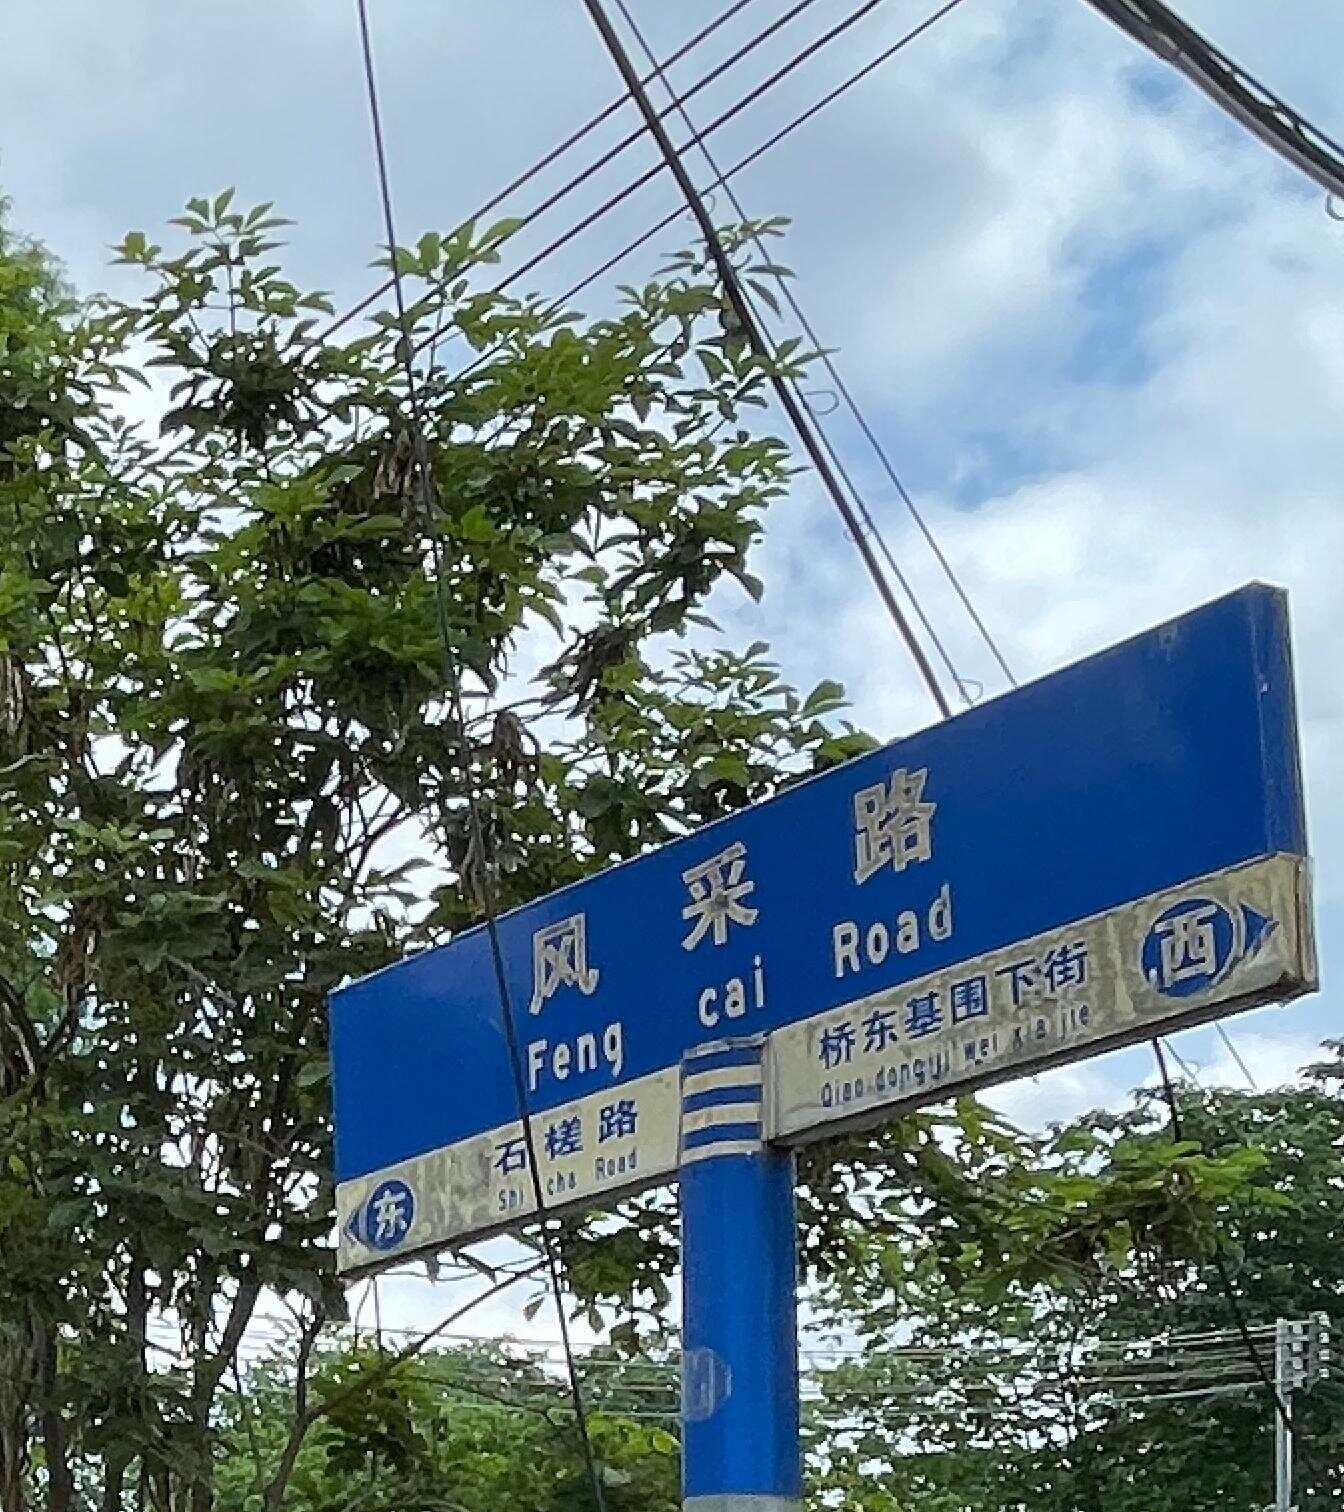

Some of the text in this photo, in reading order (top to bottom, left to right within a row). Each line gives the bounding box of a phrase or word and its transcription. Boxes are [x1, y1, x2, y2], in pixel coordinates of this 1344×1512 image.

[529, 767, 937, 1015] 风采路
[527, 882, 953, 1092] Feng cai Road
[1154, 904, 1219, 991] 西
[818, 940, 1089, 1070] 桥东基围下街
[373, 1189, 408, 1242] 东
[595, 1148, 637, 1181] Road
